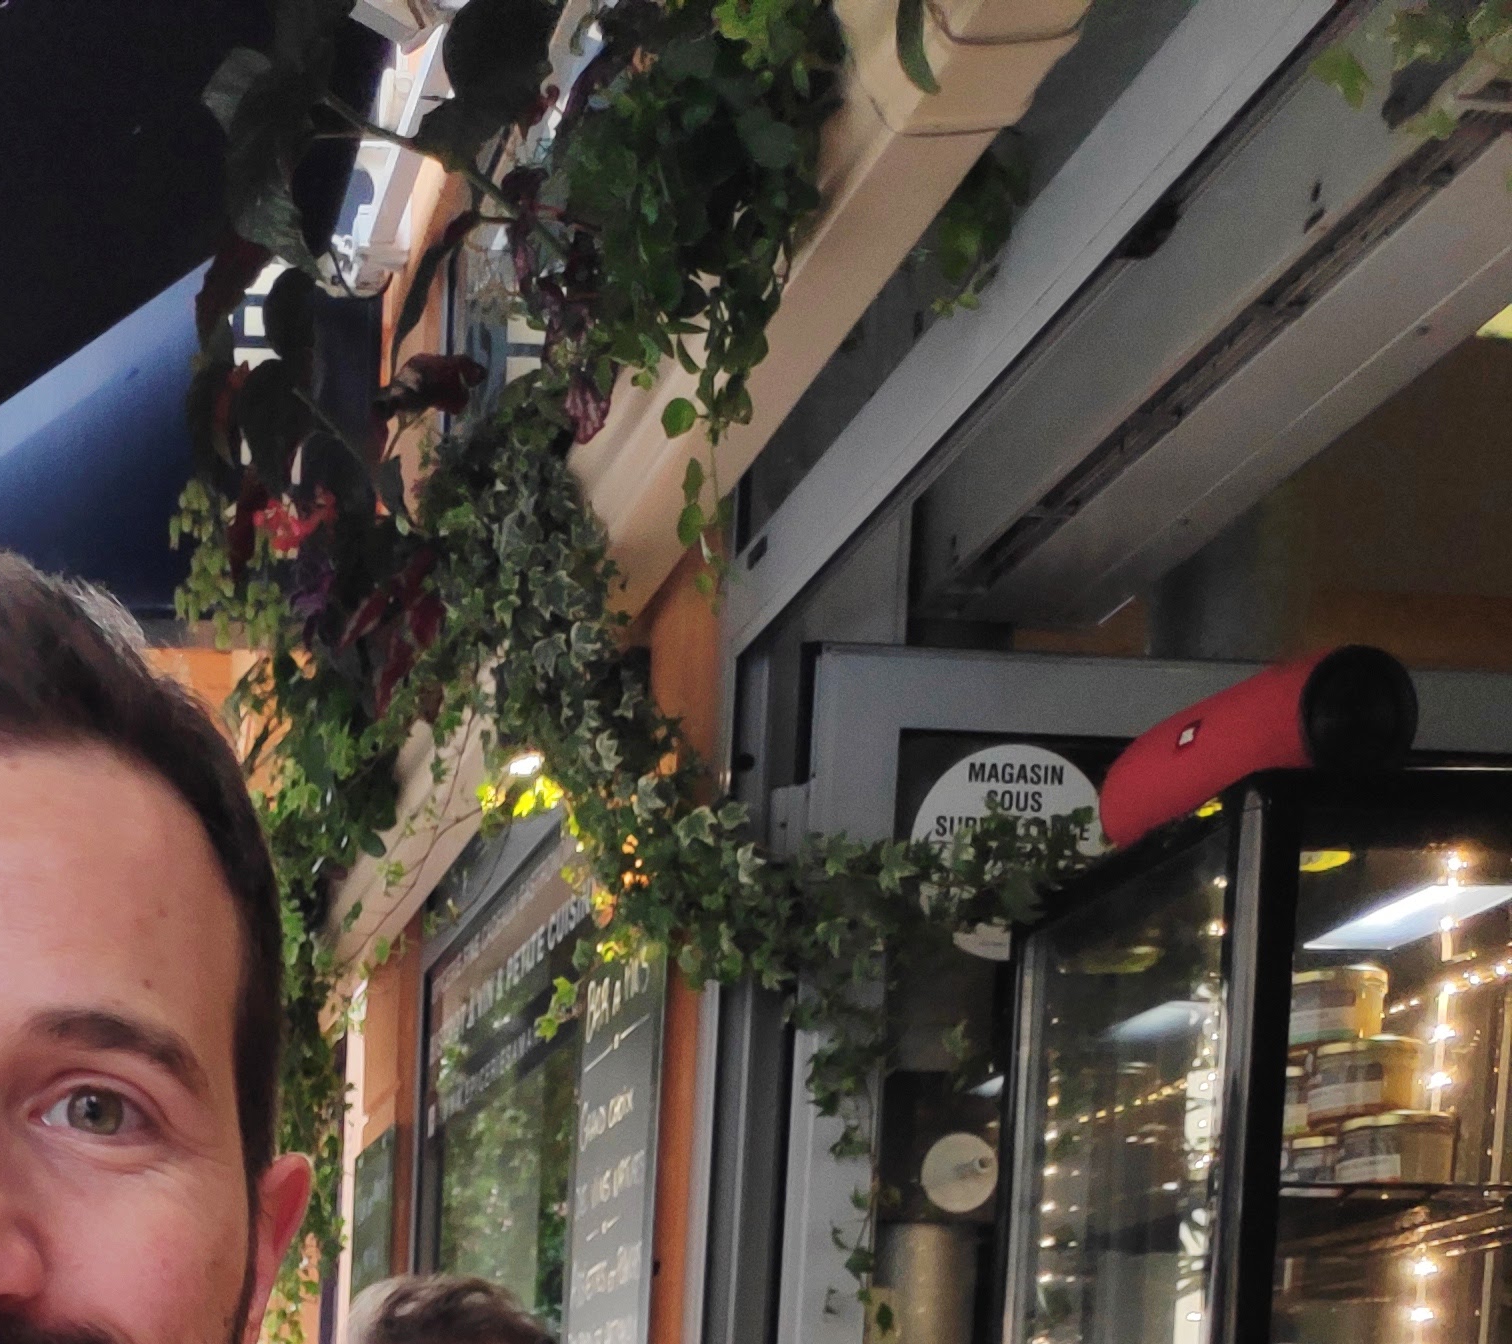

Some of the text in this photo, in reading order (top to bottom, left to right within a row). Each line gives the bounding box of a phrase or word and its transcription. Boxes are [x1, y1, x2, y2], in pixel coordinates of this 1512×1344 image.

[967, 762, 1065, 786] MAGASIN
[986, 789, 1044, 813] SOUS
[586, 976, 611, 1045] BAR
